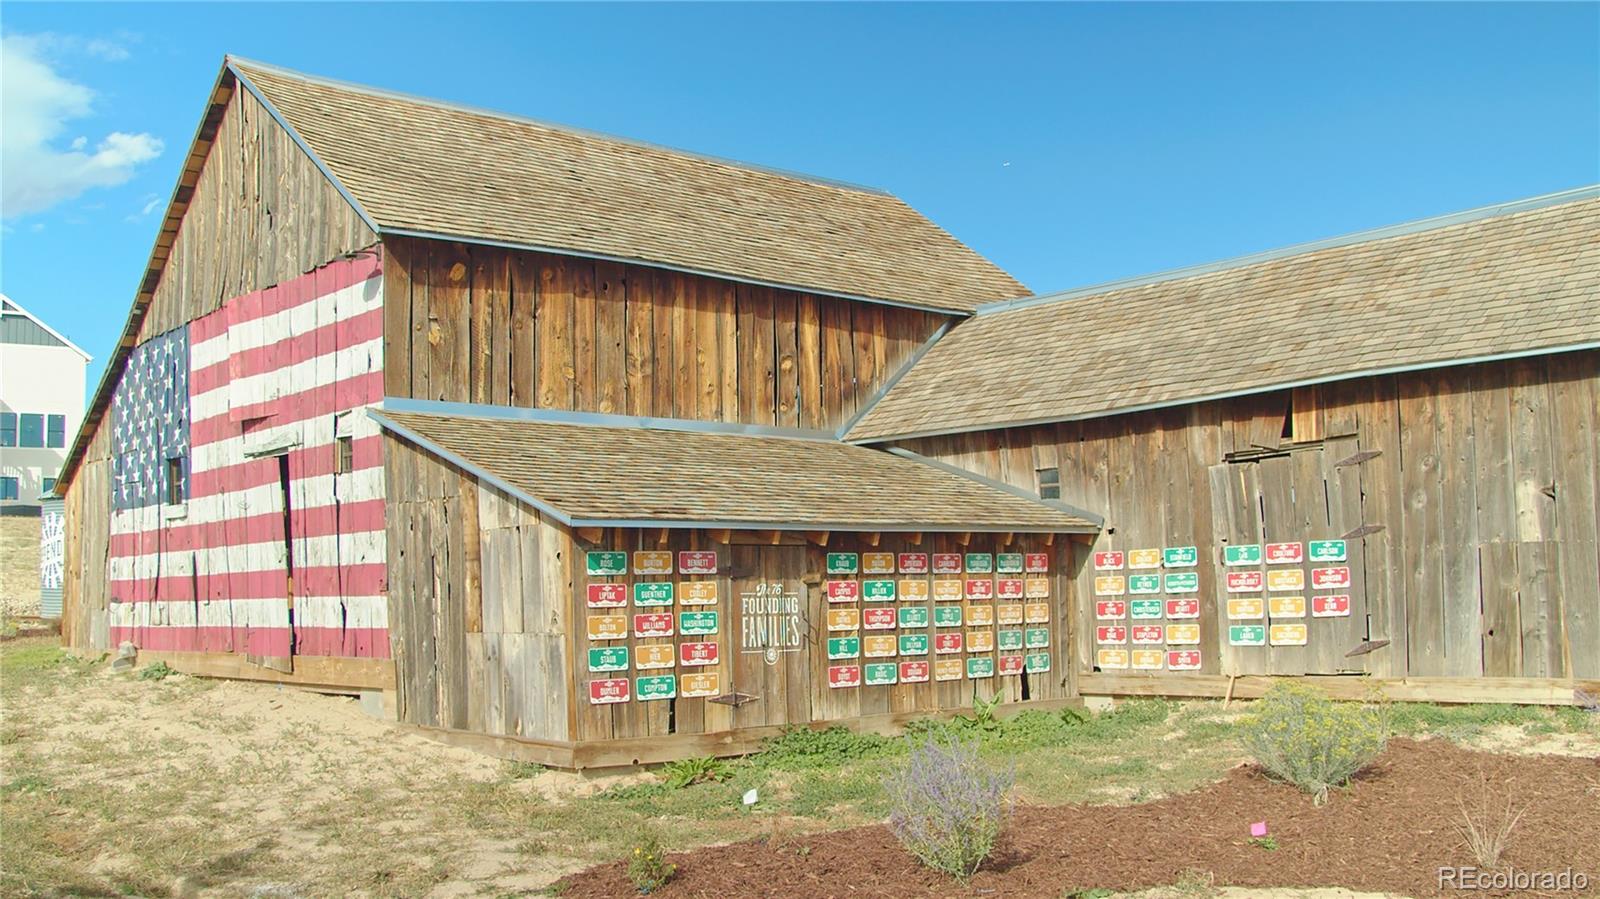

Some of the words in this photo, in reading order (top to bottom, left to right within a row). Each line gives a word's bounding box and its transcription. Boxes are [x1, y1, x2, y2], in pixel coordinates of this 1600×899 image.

[599, 559, 614, 567] ROSE
[687, 559, 709, 567] BENNETT
[771, 583, 783, 595] 76
[641, 590, 666, 599] GUENTHER
[742, 597, 799, 615] FOUNDING
[642, 621, 666, 629] WILLIAMS
[683, 619, 714, 628] WASHINGTON
[742, 616, 800, 648] FAMILIES
[644, 683, 668, 693] COMPTON
